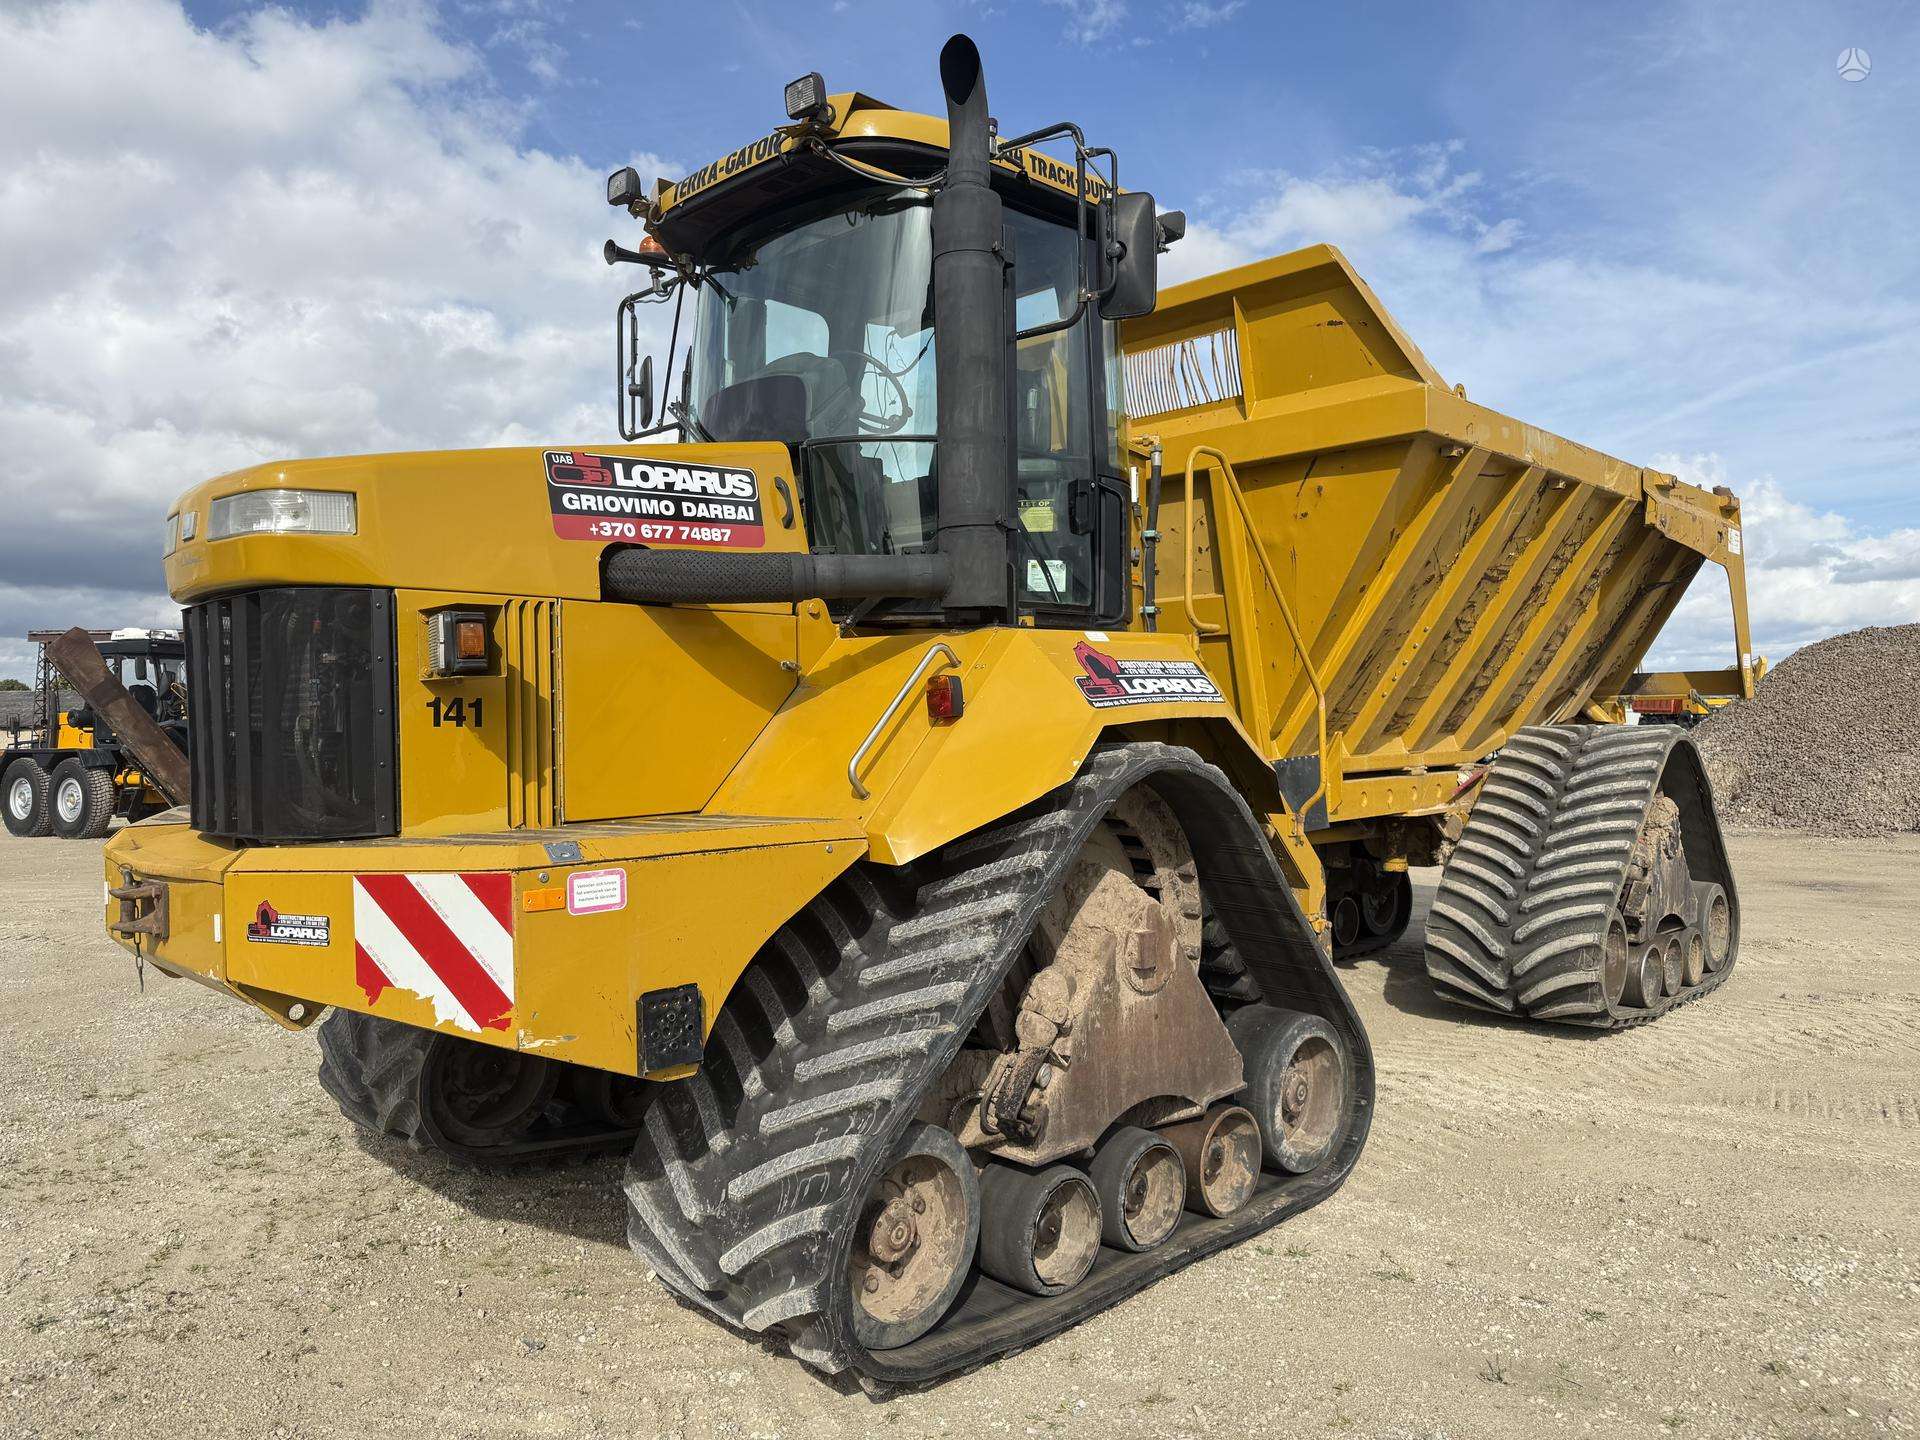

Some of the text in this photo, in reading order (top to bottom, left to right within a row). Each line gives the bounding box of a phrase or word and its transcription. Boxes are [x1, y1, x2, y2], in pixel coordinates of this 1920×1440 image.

[551, 454, 574, 465] UAB
[613, 462, 754, 498] LOPARUS
[562, 492, 755, 521] GRIOVIMO DARBAI
[589, 521, 731, 542] +370 677 74887
[1119, 678, 1216, 695] LOPARUS
[425, 696, 483, 728] 141
[270, 926, 328, 940] LOPARUS
